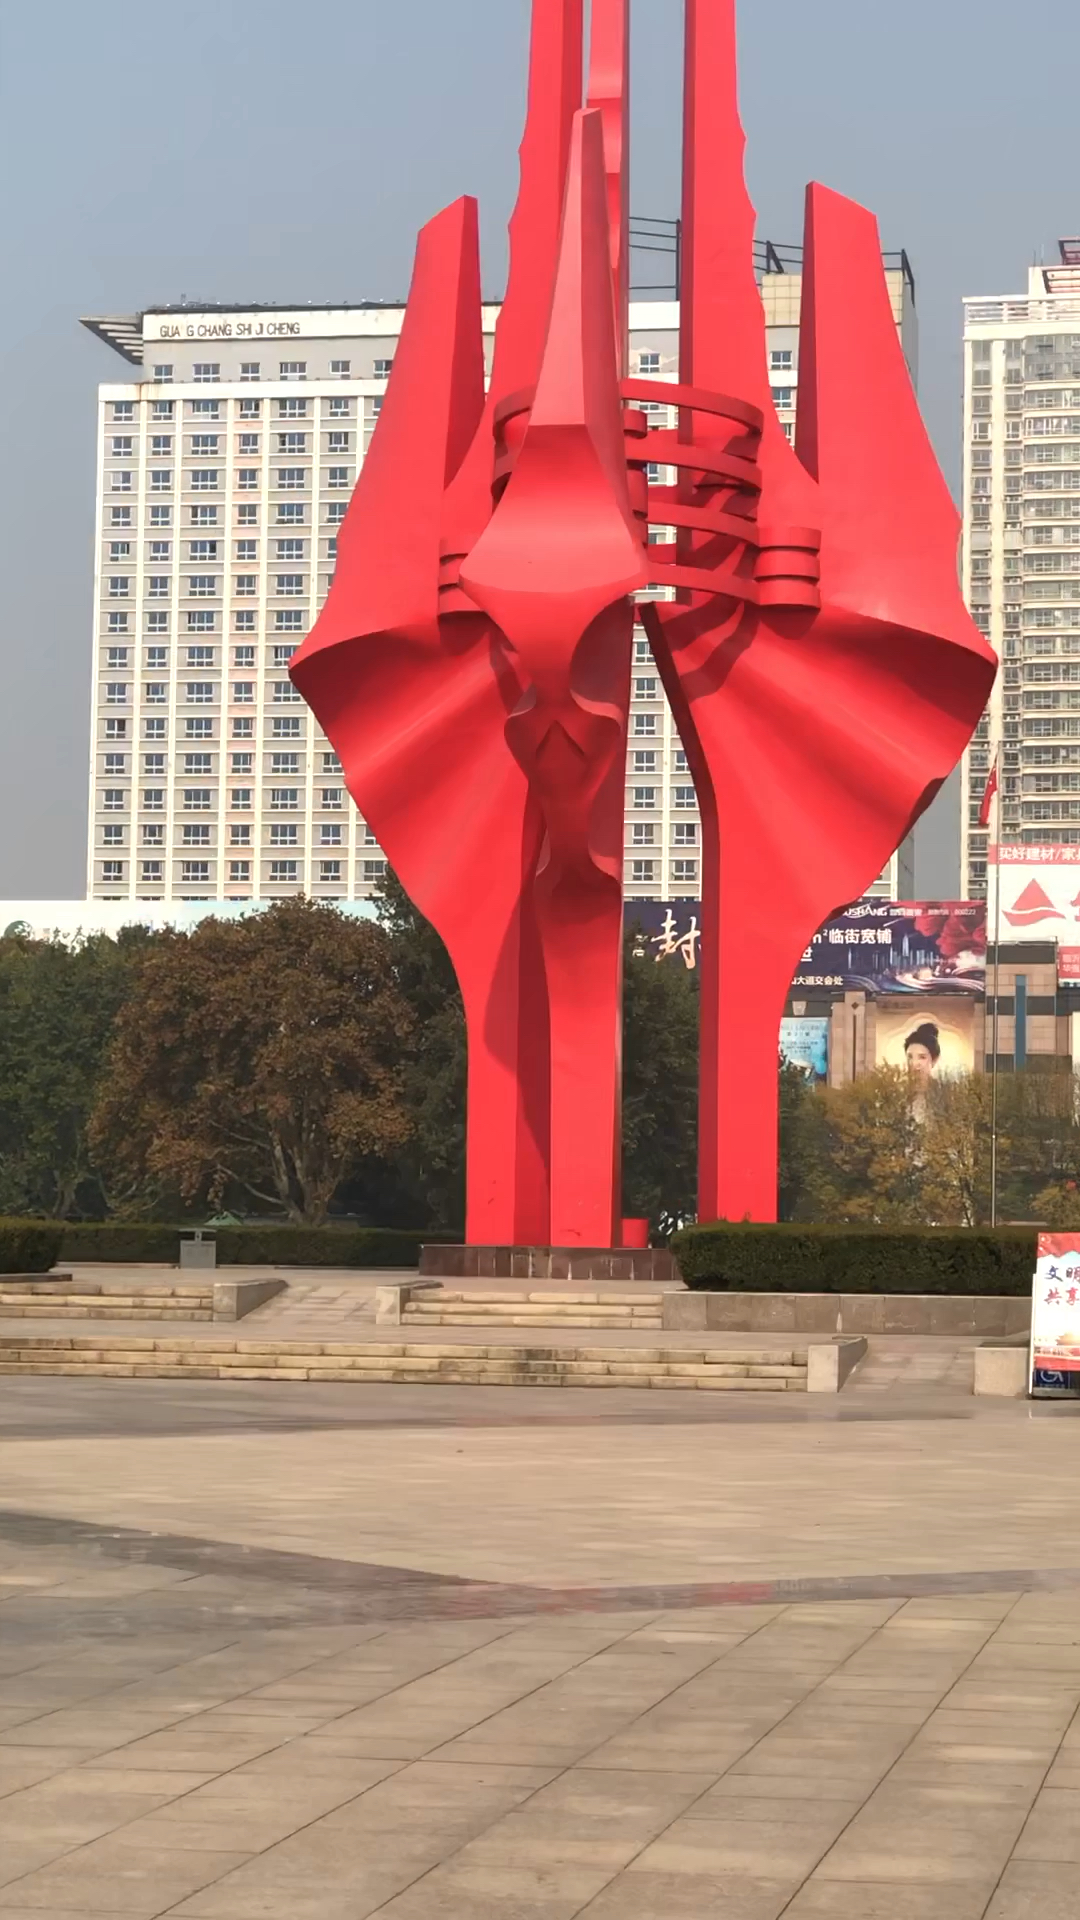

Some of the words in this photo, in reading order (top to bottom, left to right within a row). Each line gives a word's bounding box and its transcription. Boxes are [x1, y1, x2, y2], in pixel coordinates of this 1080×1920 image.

[197, 323, 232, 337] CHANG
[236, 323, 252, 336] SHI
[255, 323, 263, 336] JI
[266, 322, 300, 336] CHENG
